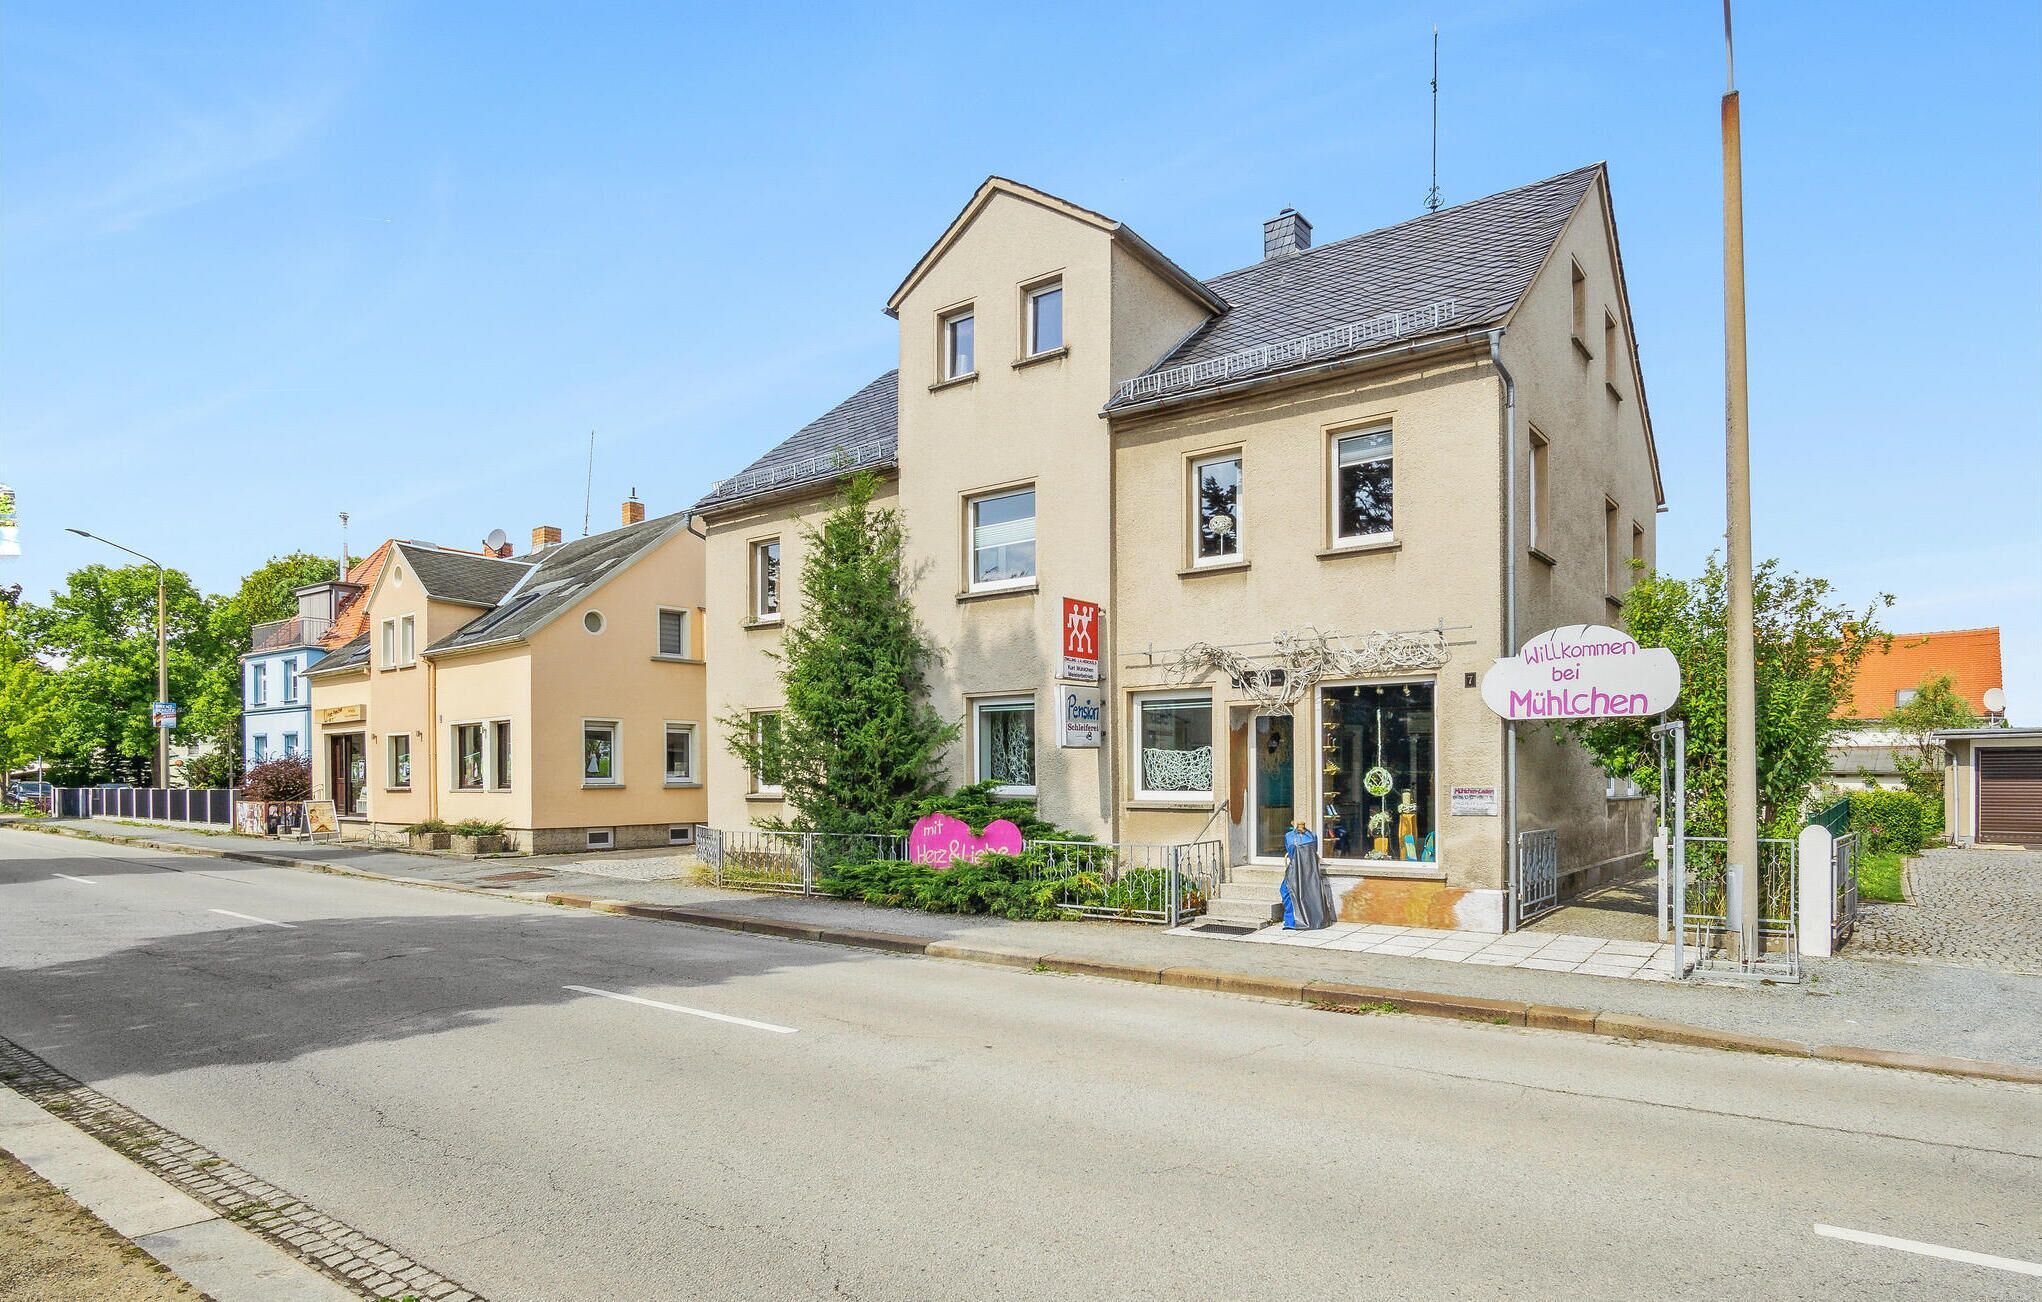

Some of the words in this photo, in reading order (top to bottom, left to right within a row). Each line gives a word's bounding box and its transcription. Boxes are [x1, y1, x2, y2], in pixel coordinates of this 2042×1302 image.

[1524, 639, 1636, 665] Willkommen
[1467, 676, 1473, 684] 7
[1552, 663, 1581, 682] bei
[1067, 694, 1099, 720] Pension
[1509, 687, 1648, 718] Mühlchen
[1067, 723, 1099, 732] Schleiferei
[923, 820, 944, 837] mit
[917, 844, 947, 864] Herz
